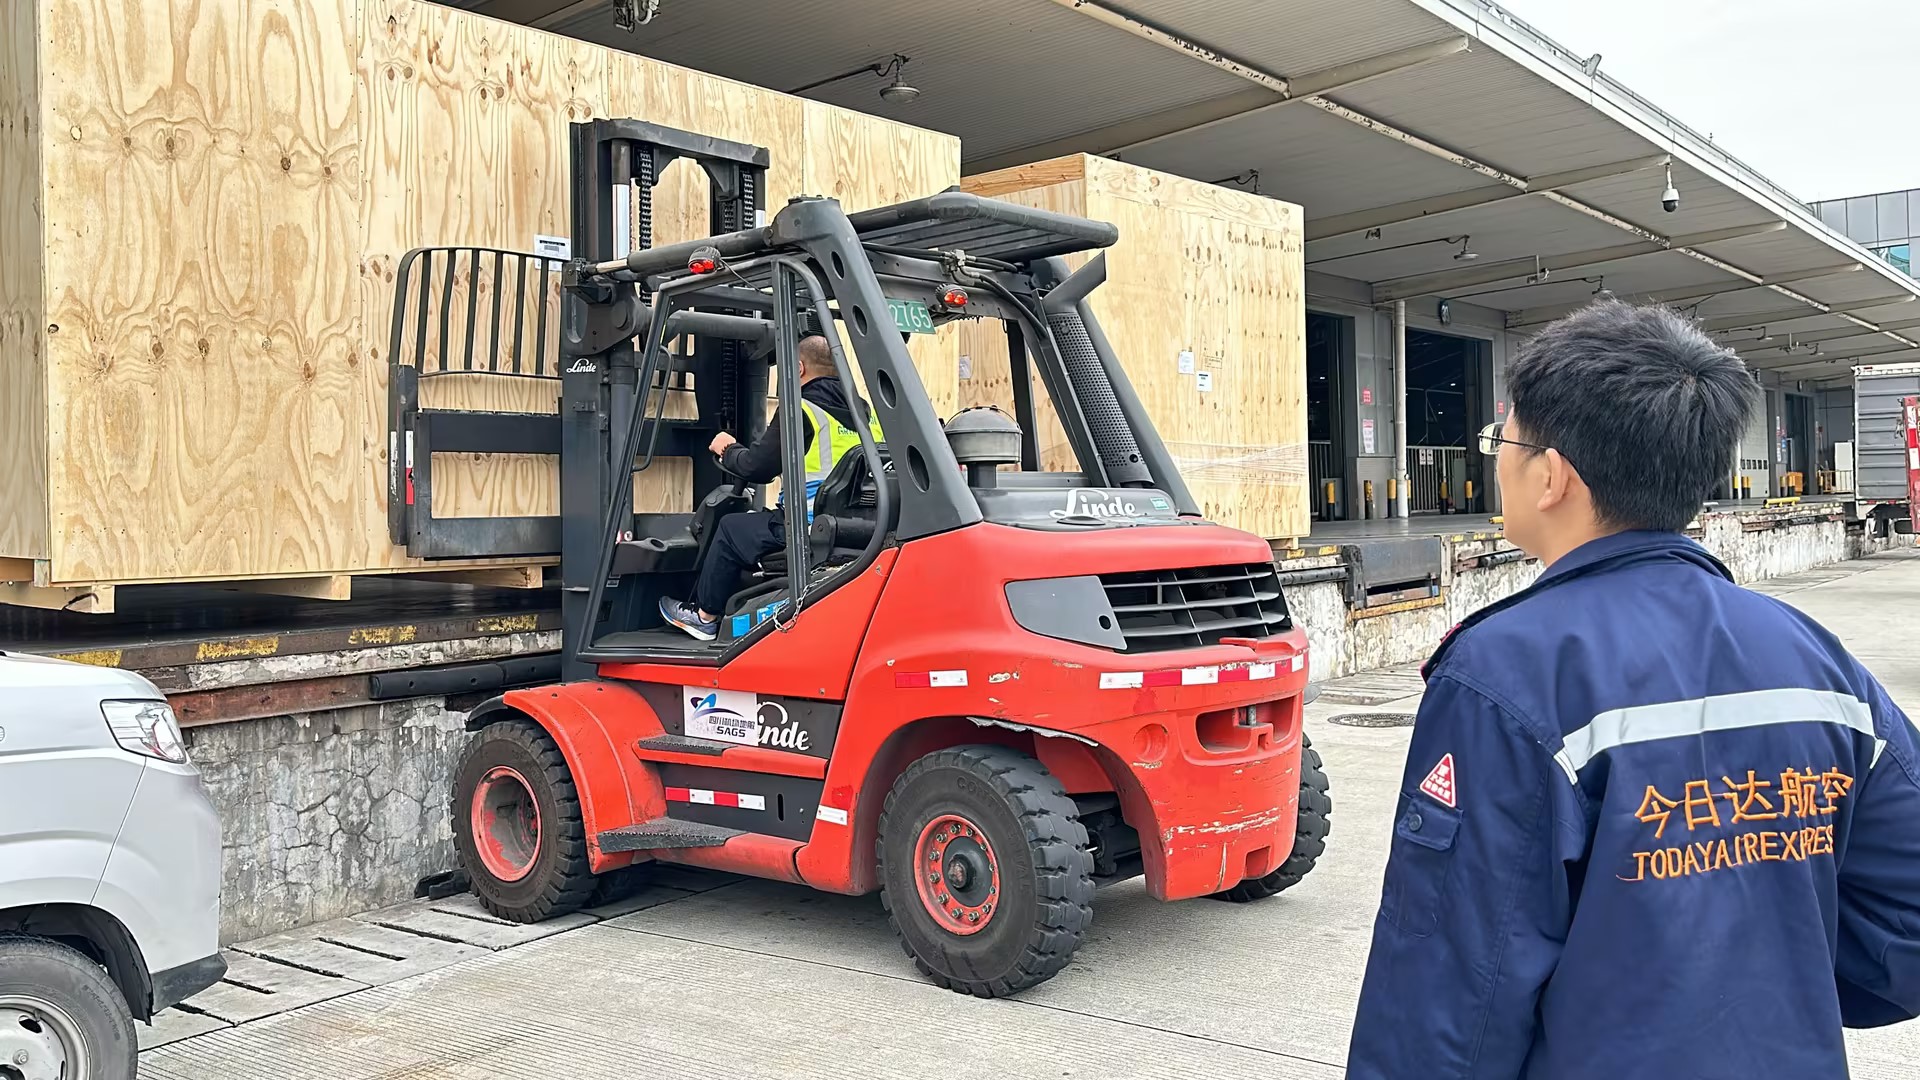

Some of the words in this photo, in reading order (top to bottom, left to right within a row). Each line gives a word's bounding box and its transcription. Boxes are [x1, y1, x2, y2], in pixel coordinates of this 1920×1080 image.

[889, 304, 931, 329] 2765
[566, 358, 597, 373] Linde
[1050, 488, 1143, 519] Linde
[717, 726, 746, 738] SAGS
[757, 701, 810, 751] inde
[1634, 766, 1854, 839] 今日达航空
